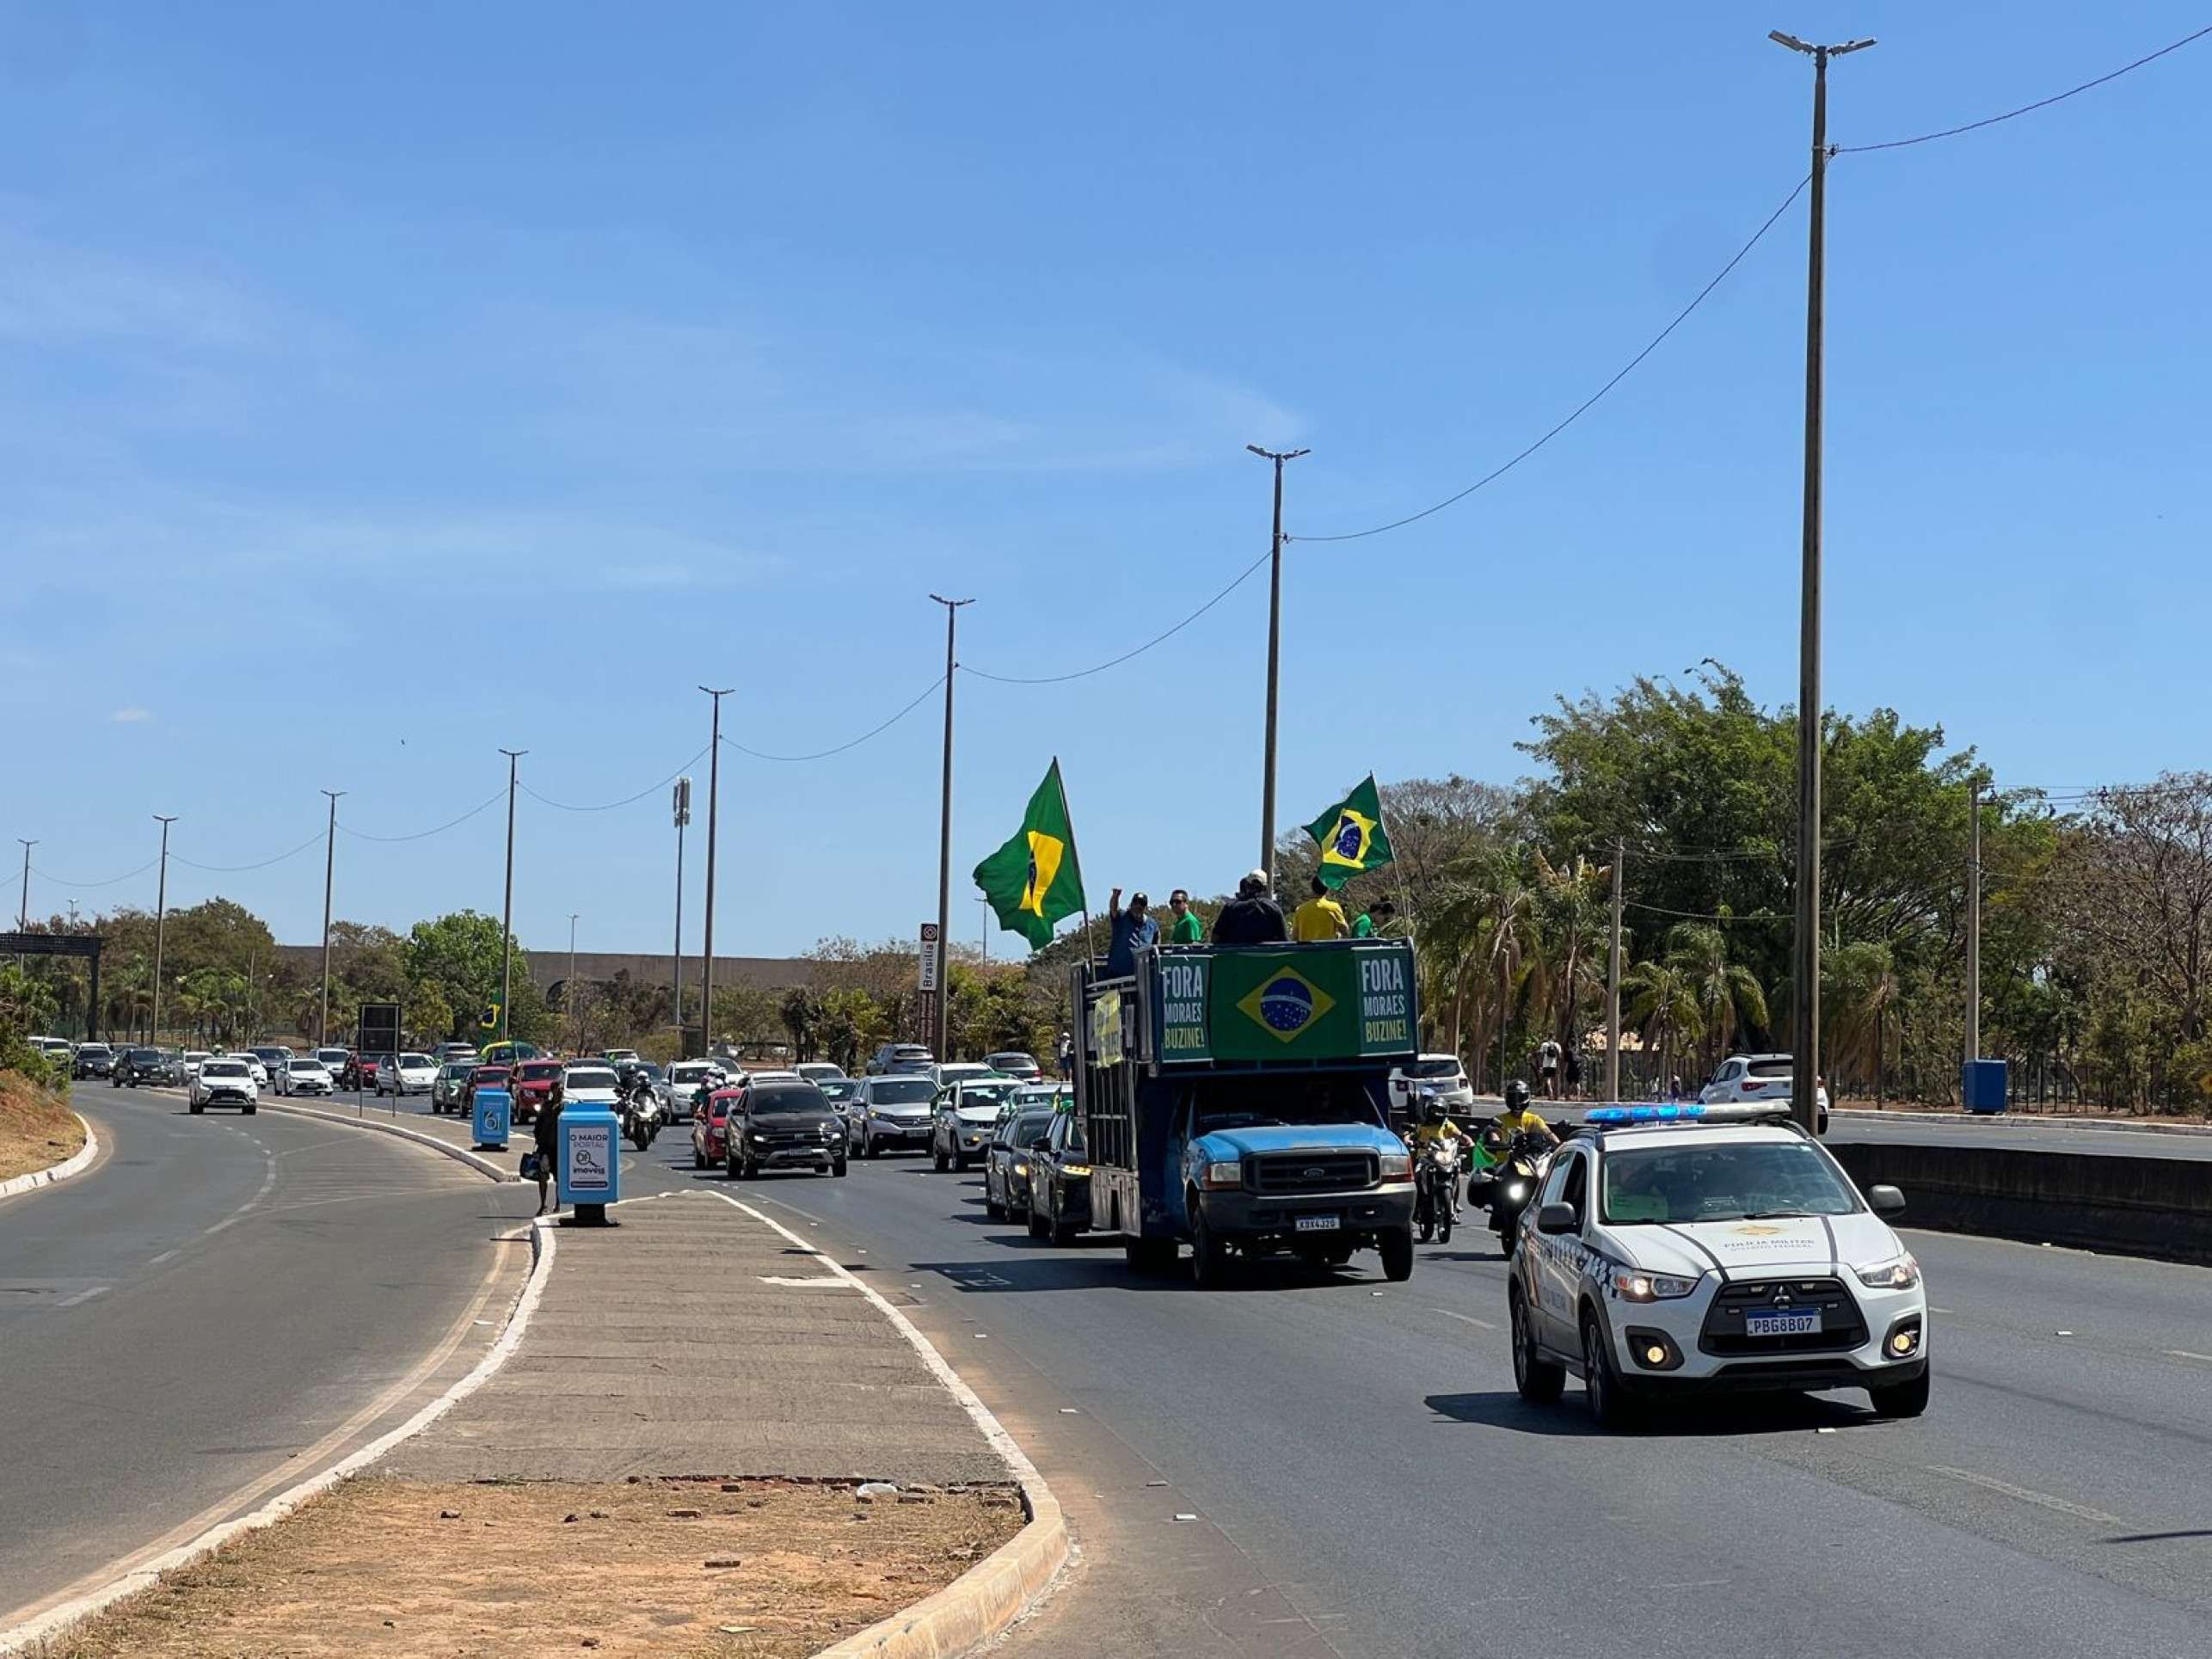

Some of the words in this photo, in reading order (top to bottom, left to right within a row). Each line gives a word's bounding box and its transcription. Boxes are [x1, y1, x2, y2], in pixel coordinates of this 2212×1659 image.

[1163, 965, 1203, 998] FORA
[1361, 957, 1404, 992] FORA
[1164, 1003, 1202, 1023] MORAES
[1363, 994, 1405, 1017] MORAES
[1164, 1028, 1205, 1049] BUZINE!
[1365, 1019, 1408, 1043] BUZINE!
[1754, 1318, 1813, 1333] PBG8B07
